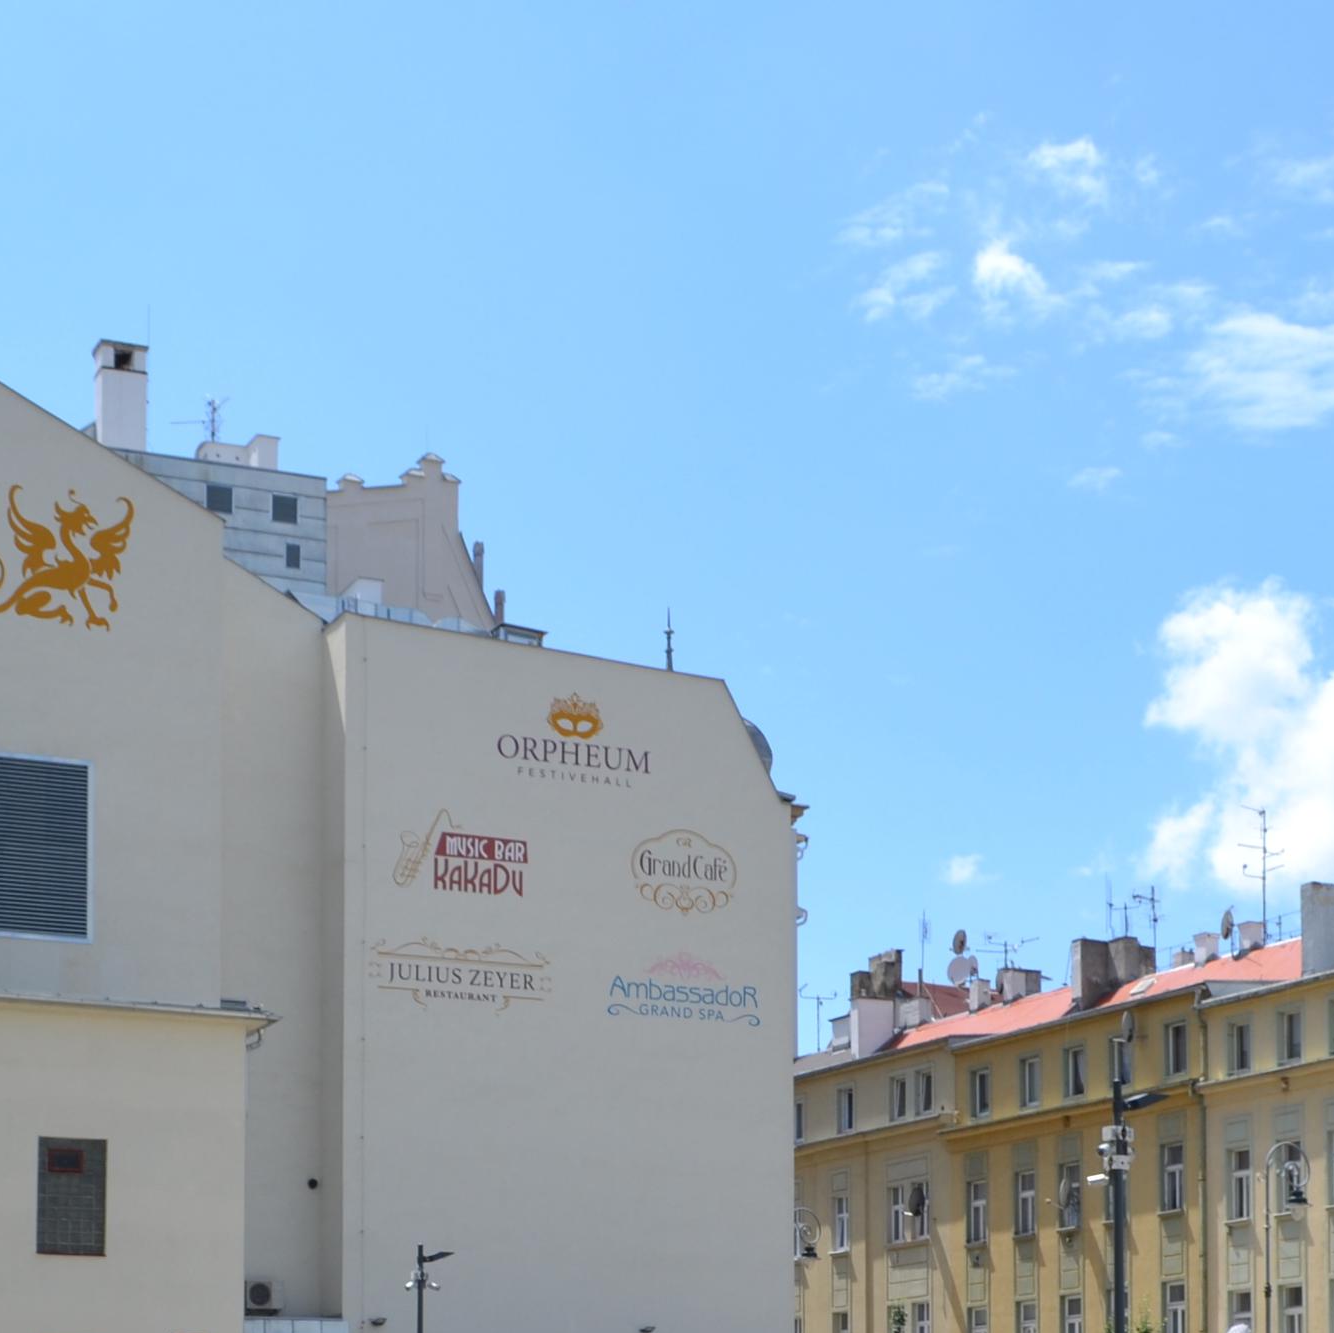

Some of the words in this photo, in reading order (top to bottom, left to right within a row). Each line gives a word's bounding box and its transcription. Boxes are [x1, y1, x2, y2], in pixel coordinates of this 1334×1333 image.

[496, 733, 652, 775] ORPHEUM
[517, 766, 632, 789] FESTIVEHALL
[445, 835, 489, 859] MUSIC
[494, 840, 525, 863] BAR
[433, 857, 524, 898] KAKADU
[388, 962, 463, 985] JULIUS
[468, 969, 536, 991] ZEYER
[425, 989, 497, 1002] RESTAURANT
[638, 1003, 694, 1020] GRAND
[698, 1008, 726, 1022] SPA
